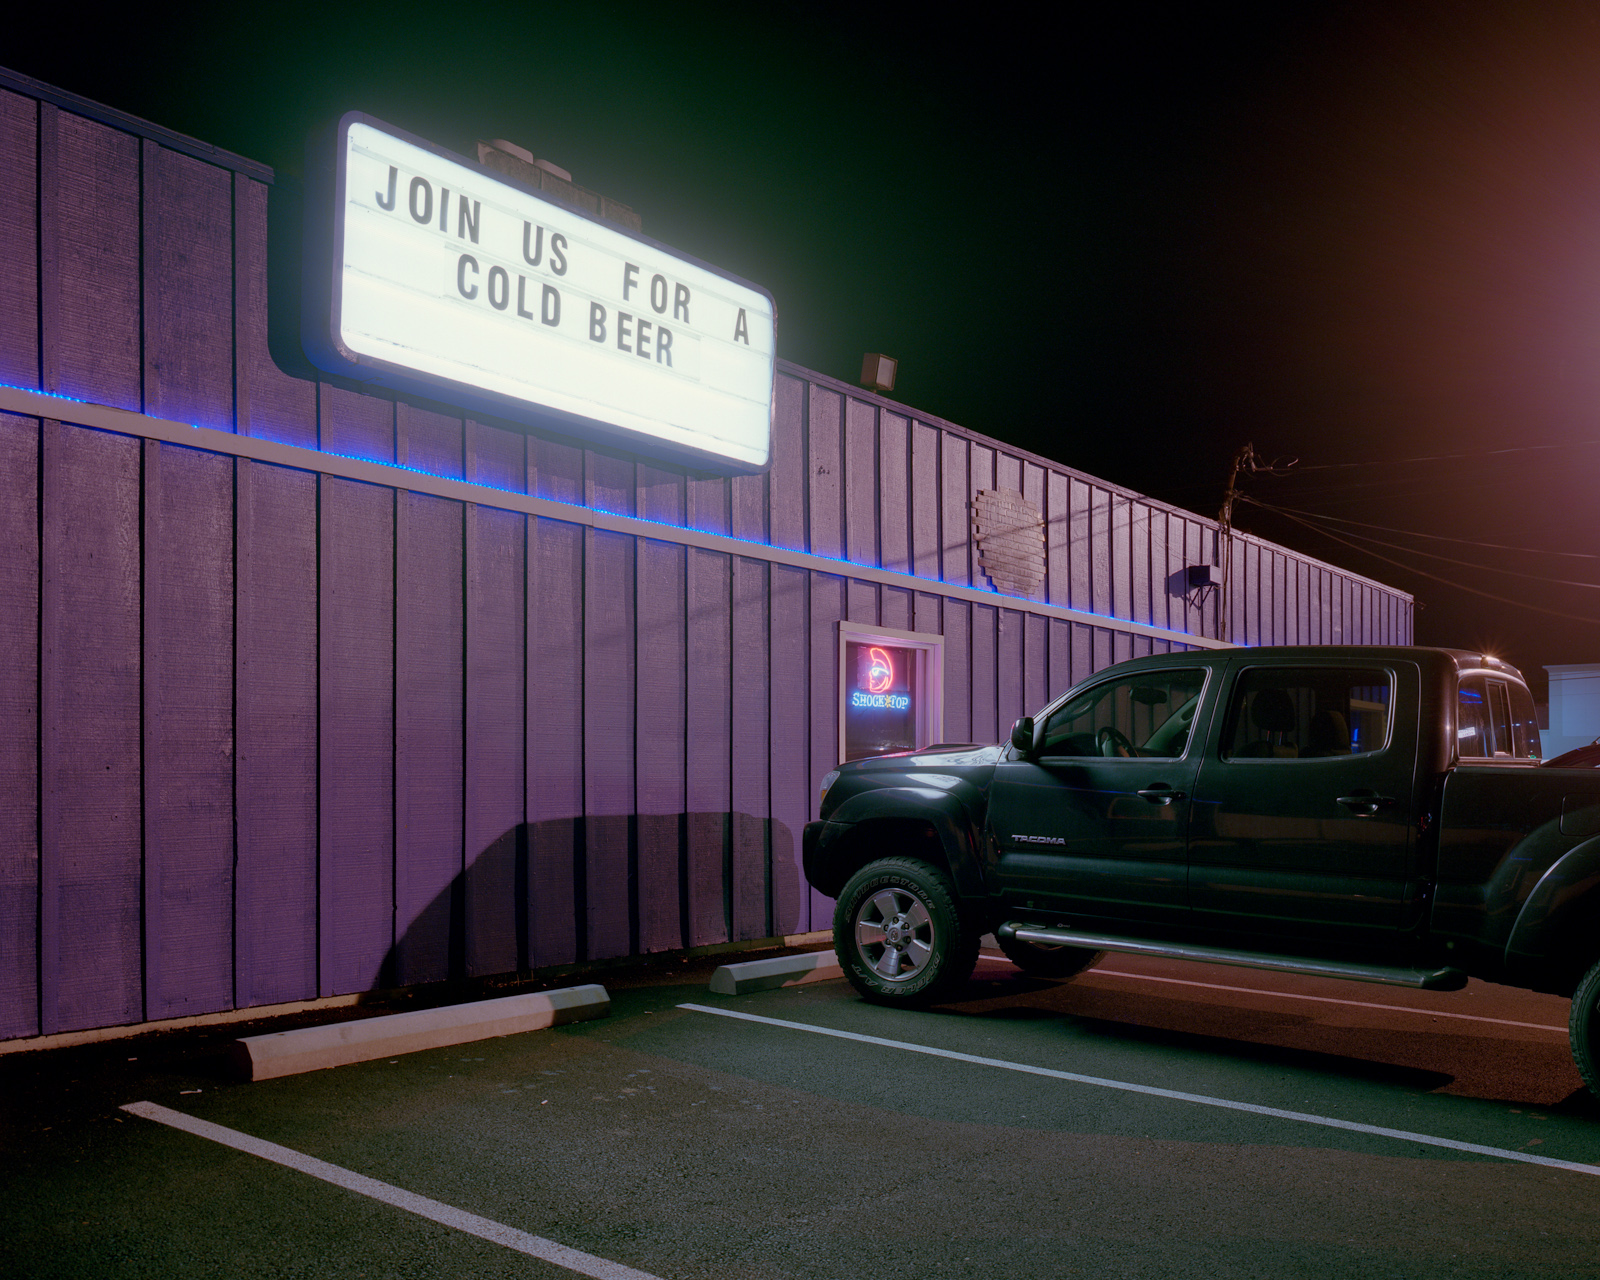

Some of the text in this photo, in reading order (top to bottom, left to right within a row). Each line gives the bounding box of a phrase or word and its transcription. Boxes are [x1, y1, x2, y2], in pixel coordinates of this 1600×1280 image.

[375, 165, 750, 346] JOIN US FOR A
[457, 254, 674, 368] COLD BEER
[890, 695, 909, 709] TOP
[1011, 834, 1066, 846] TACOMA
